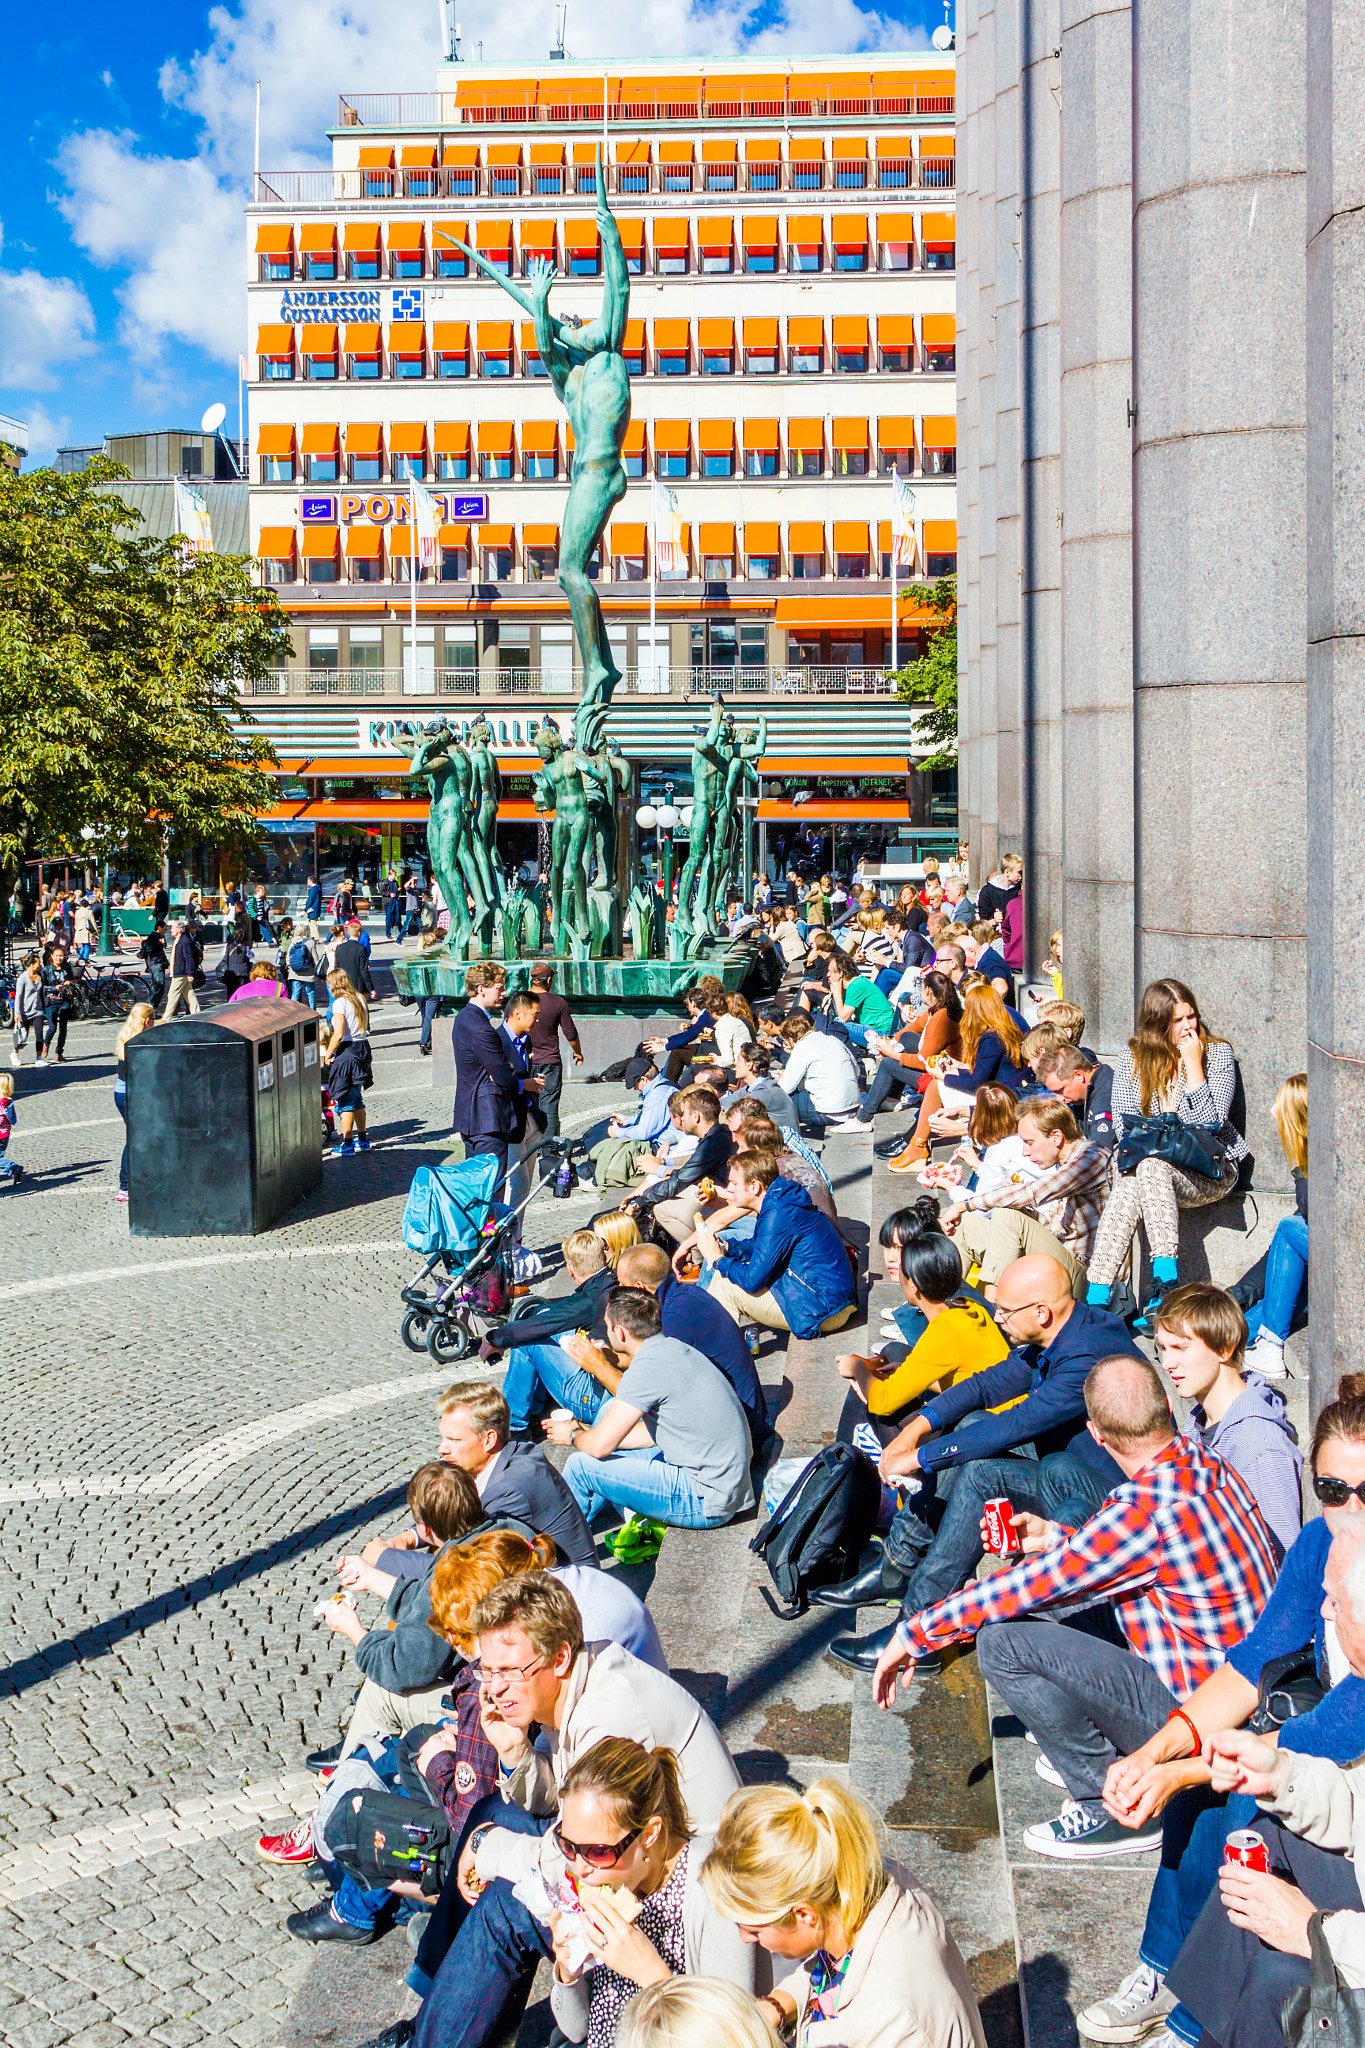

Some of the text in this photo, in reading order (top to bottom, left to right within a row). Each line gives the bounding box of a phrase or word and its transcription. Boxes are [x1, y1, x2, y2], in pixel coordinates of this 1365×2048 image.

[281, 289, 380, 304] ANDERSSON
[280, 305, 380, 321] GUSTAFSSON
[860, 777, 891, 786] INTERNET
